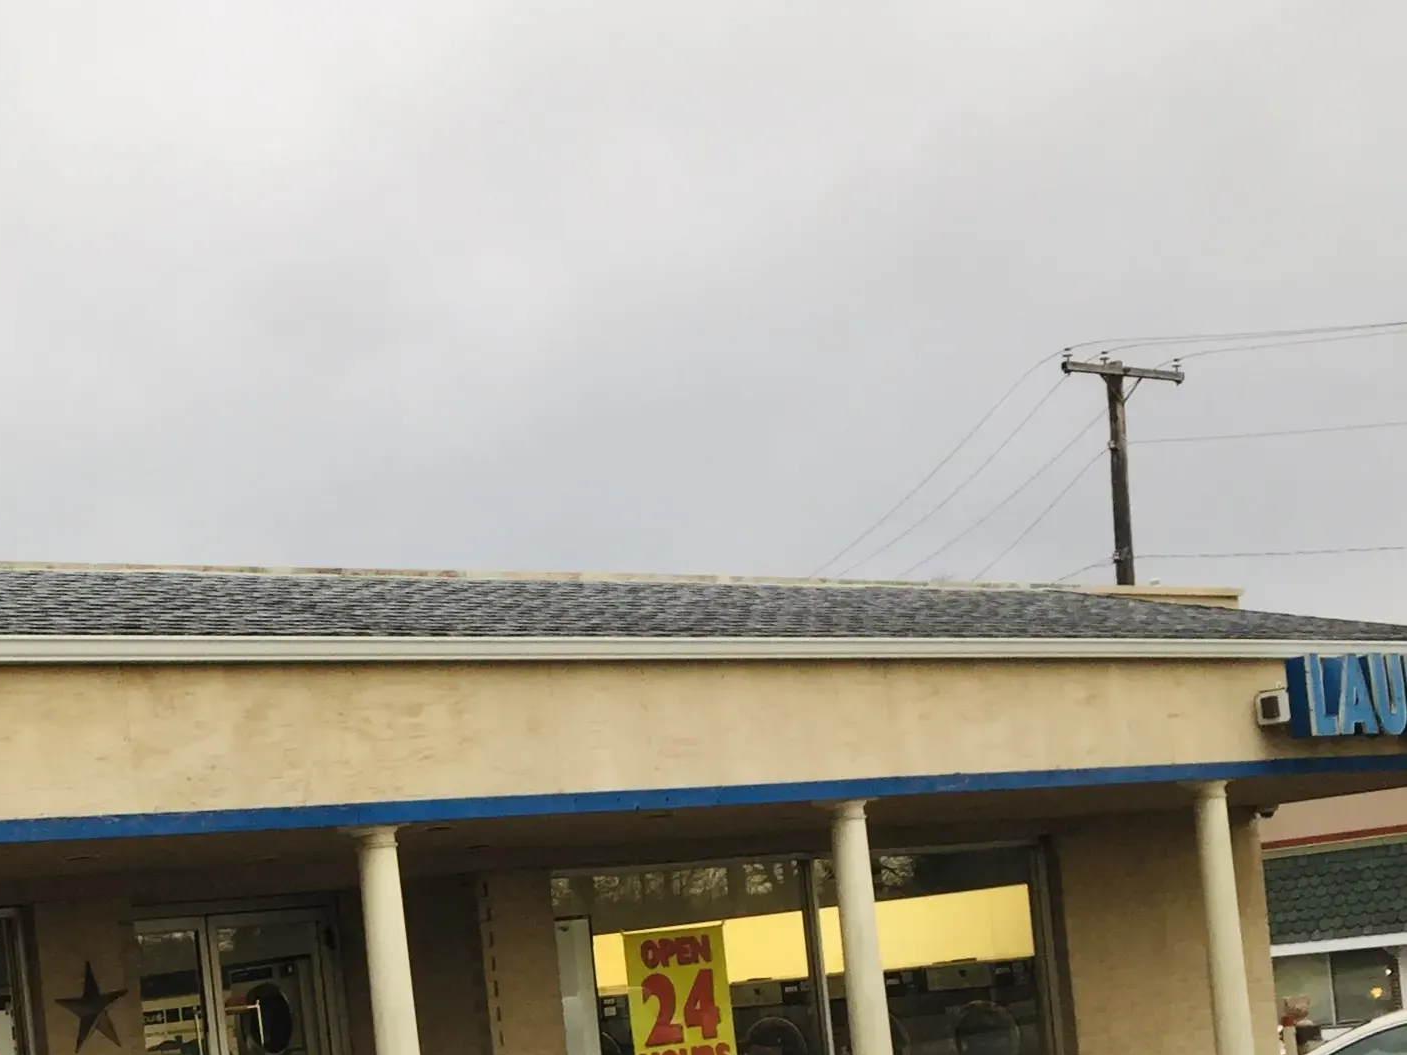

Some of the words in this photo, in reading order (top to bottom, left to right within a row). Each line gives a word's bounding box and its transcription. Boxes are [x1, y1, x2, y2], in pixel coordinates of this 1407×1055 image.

[1286, 652, 1407, 736] LAU
[640, 934, 712, 969] OPEN
[641, 968, 721, 1048] 24
